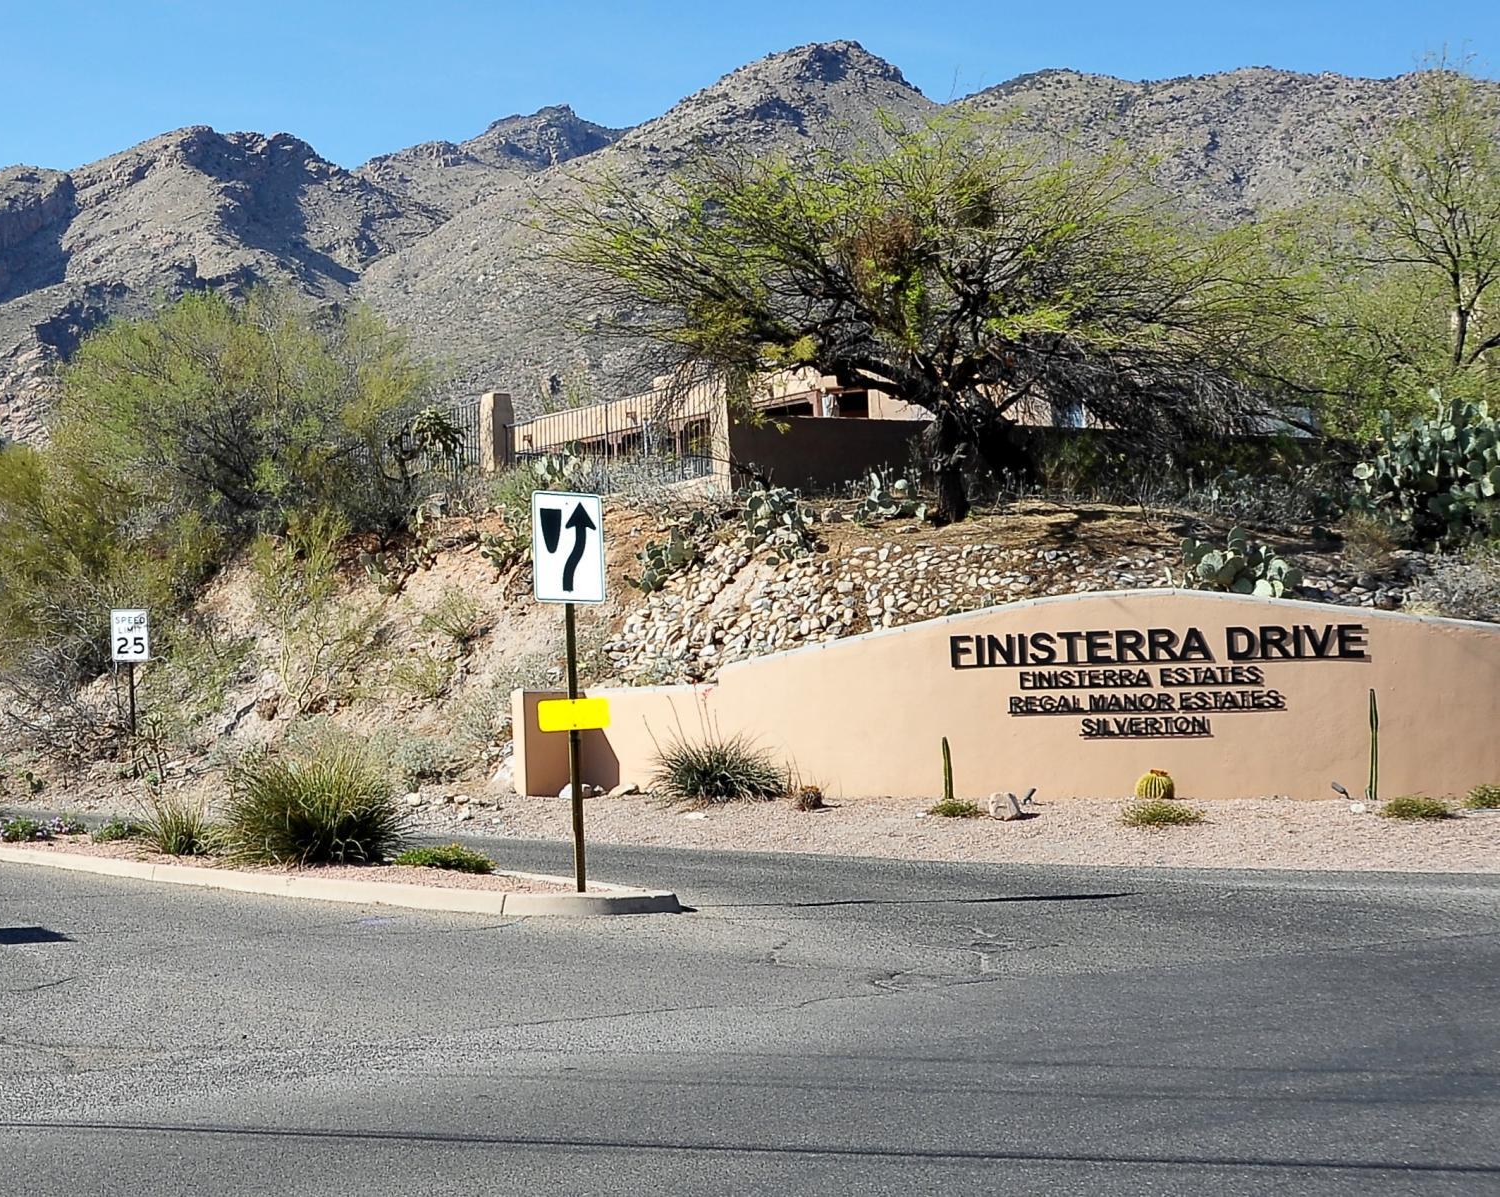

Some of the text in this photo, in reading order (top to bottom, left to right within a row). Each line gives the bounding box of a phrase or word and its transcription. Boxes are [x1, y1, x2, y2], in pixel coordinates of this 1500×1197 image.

[115, 616, 146, 625] SPEED
[118, 626, 143, 635] LIMIT
[116, 637, 145, 654] 25
[950, 624, 1371, 669] FINISTERRA DRIVE
[1019, 665, 1264, 690] FINISTERRA ESTATES
[1008, 689, 1287, 717] REGAL MANOR ESTATES
[1079, 716, 1213, 739] SILVERTON
